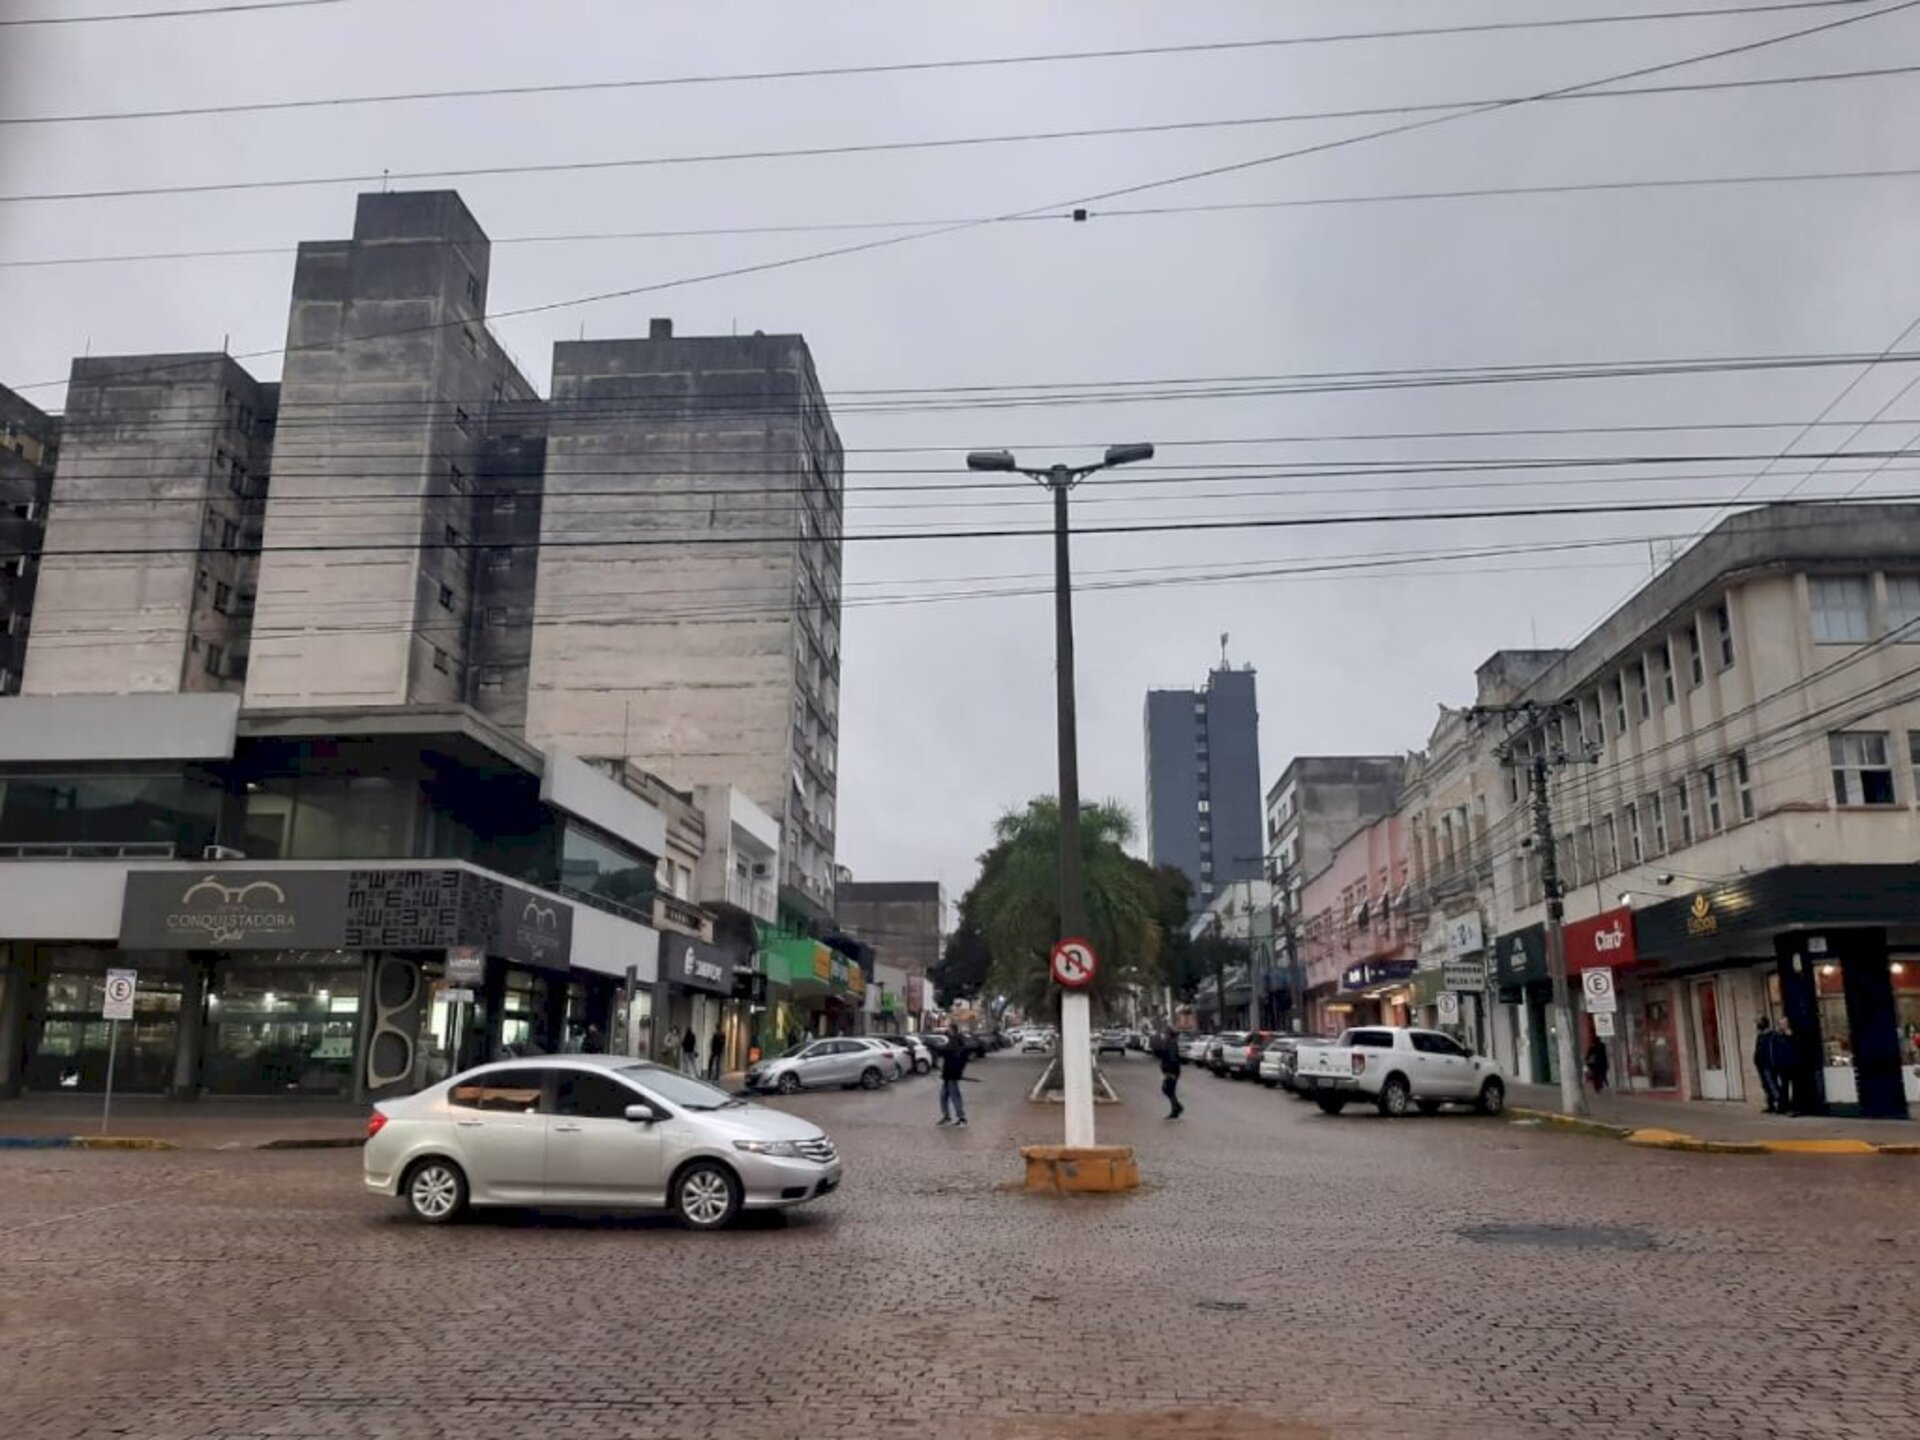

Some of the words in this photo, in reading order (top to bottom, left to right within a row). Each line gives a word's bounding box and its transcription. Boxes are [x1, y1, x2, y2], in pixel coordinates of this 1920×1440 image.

[166, 913, 296, 928] CONQUISTADORA
[115, 982, 124, 996] E
[1593, 978, 1602, 990] E
